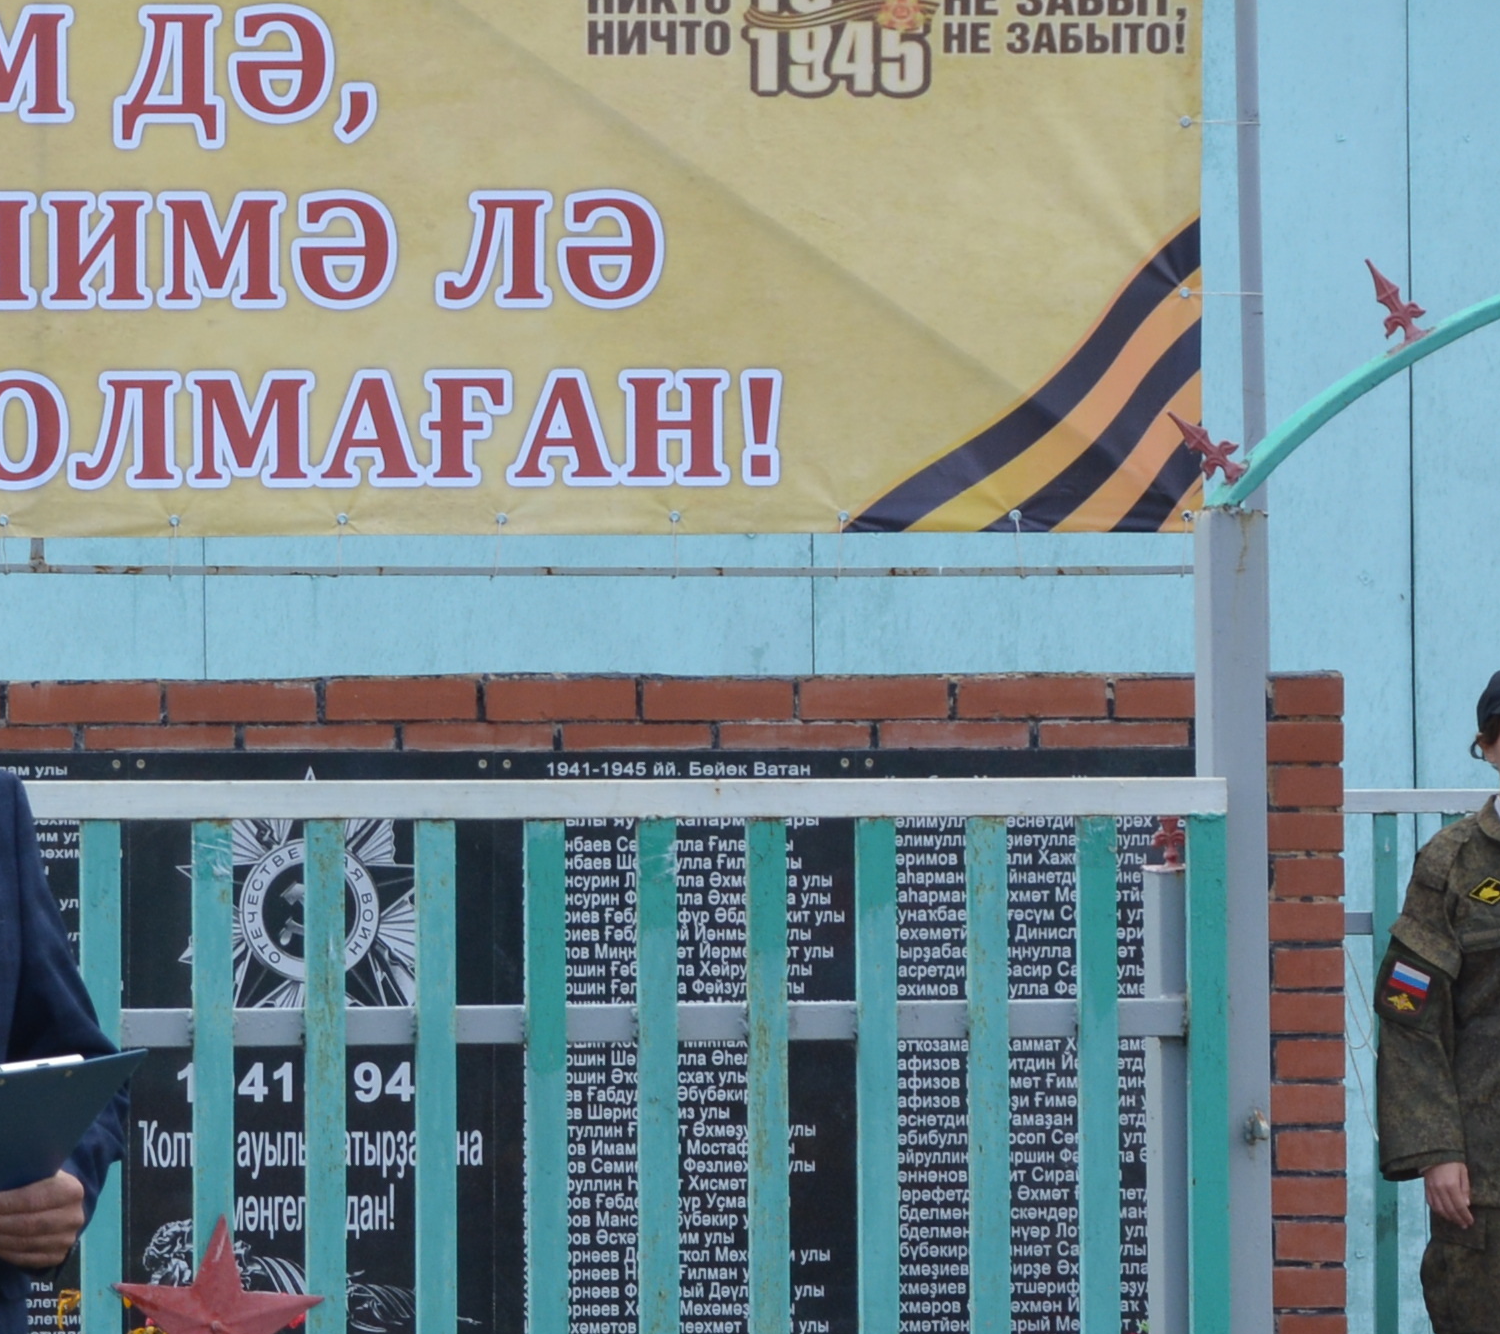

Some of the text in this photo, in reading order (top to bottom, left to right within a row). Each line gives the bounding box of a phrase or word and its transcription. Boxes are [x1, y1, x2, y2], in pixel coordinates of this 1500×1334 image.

[587, 20, 1187, 56] НИЧТО НЕ ЗАБЫТО!
[742, 20, 932, 99] 1945
[113, 5, 378, 149] ДӘ,
[435, 189, 665, 310] ЛӘ
[35, 767, 68, 780] улы
[547, 762, 647, 777] 1941-1945
[754, 762, 811, 777] Ватан
[896, 854, 957, 868] әримов
[803, 875, 832, 889] улы
[247, 846, 364, 964] ОТЕЧЕСТВЕЯ
[801, 892, 831, 906] улы
[815, 910, 845, 924] улы
[804, 946, 834, 960] улы
[897, 985, 958, 995] әхимов
[897, 1056, 959, 1074] афизов
[897, 1074, 959, 1092] афизов
[897, 1093, 959, 1111] афизов
[699, 1108, 730, 1122] улы
[897, 1149, 969, 1167] әйруллин
[704, 1233, 734, 1247] улы
[801, 1250, 831, 1264] улы
[795, 1285, 825, 1299] улы
[900, 1302, 961, 1316] хмәров
[799, 1321, 829, 1334] улы
